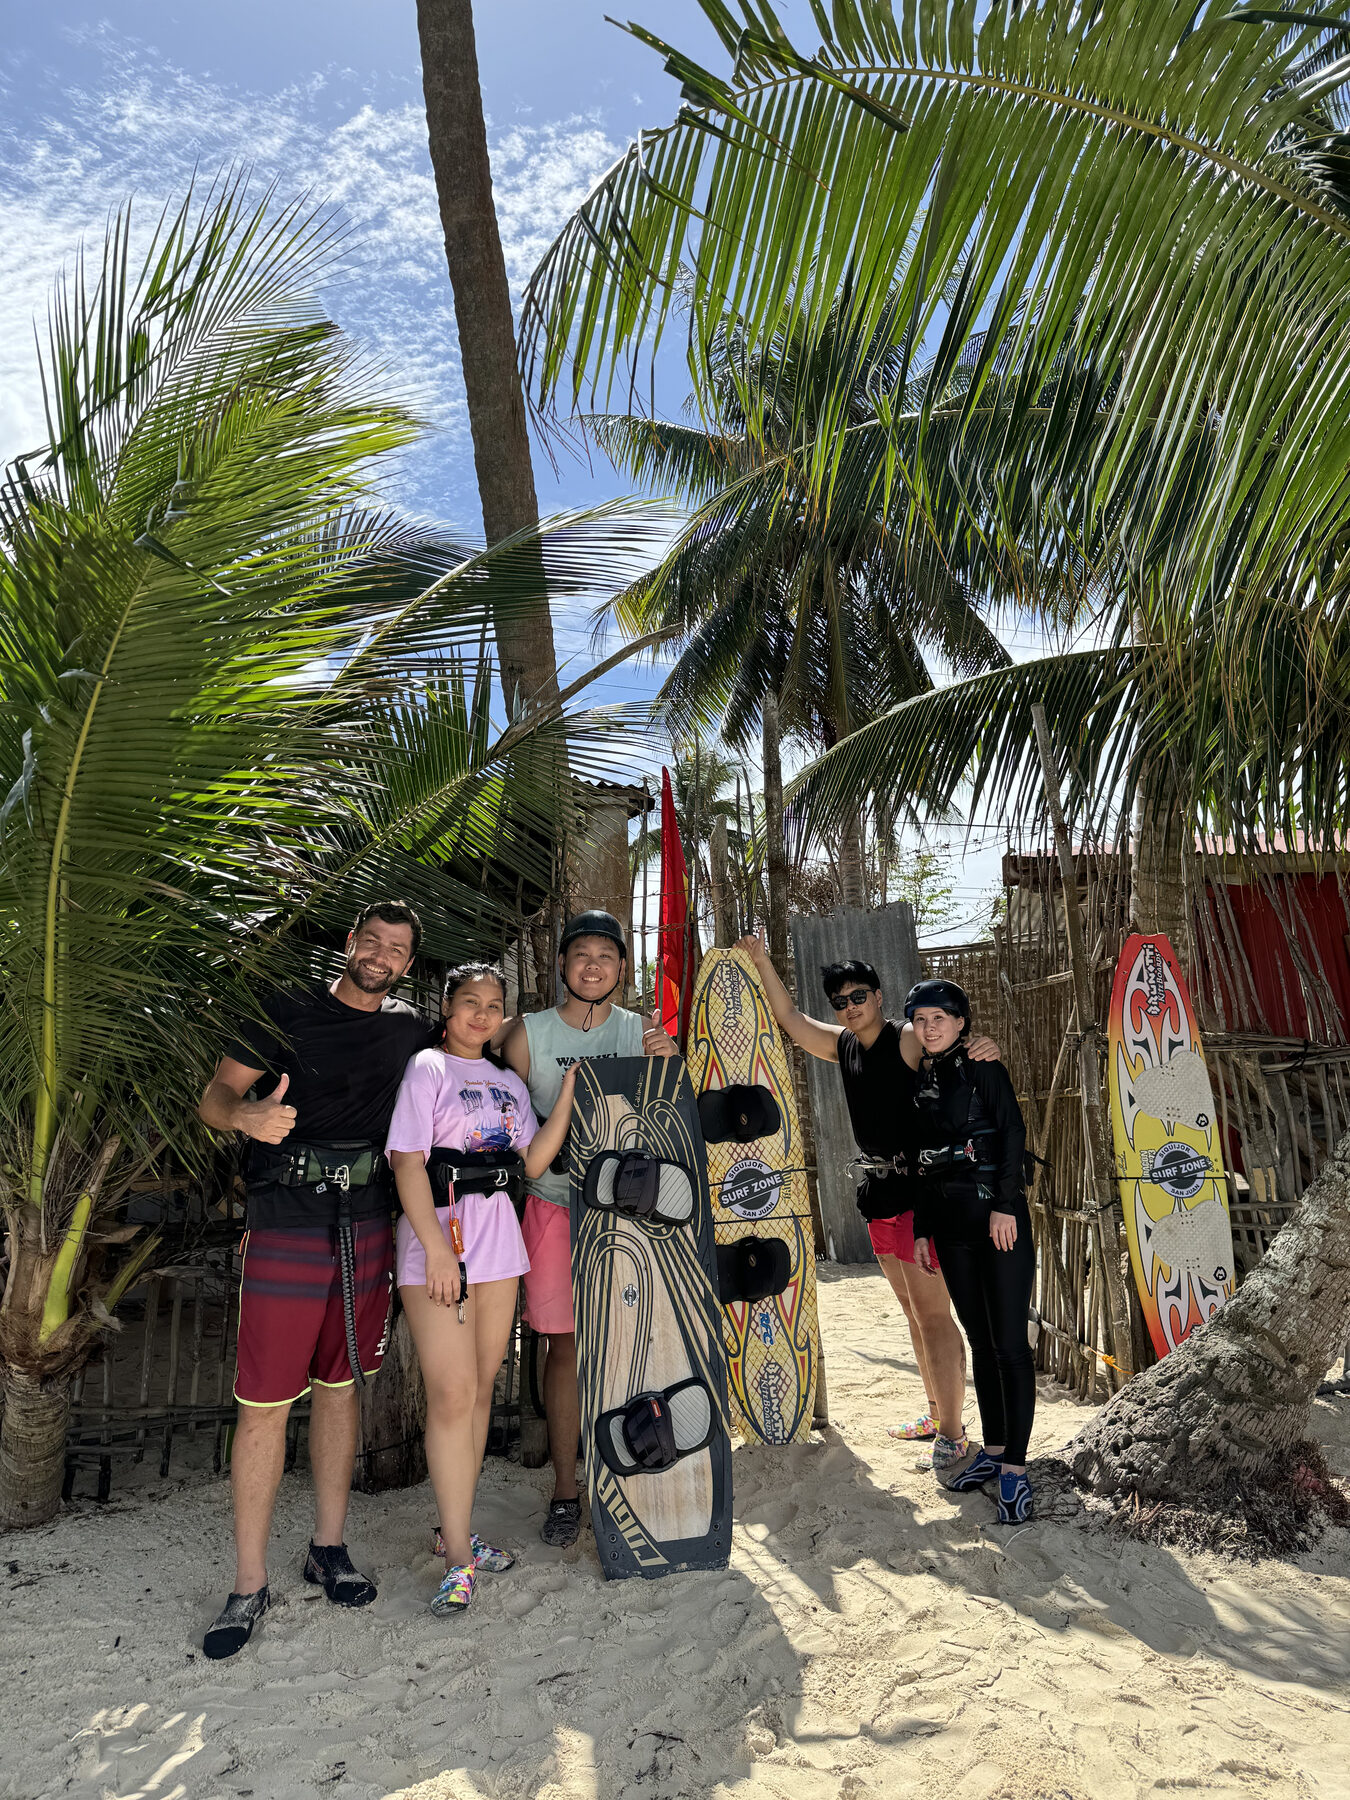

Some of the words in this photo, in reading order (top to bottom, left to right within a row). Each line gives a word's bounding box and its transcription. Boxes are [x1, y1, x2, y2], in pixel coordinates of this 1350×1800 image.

[1159, 1143, 1191, 1158] SIQUIJOR
[728, 1161, 764, 1179] SIQUIJOR
[1151, 1167, 1178, 1182] SURF
[1179, 1158, 1206, 1174] ZONE
[721, 1186, 750, 1205] SURF
[751, 1173, 782, 1193] ZONE
[1170, 1188, 1185, 1196] SAN
[1185, 1183, 1200, 1195] JUAN
[758, 1202, 775, 1216] JUAN
